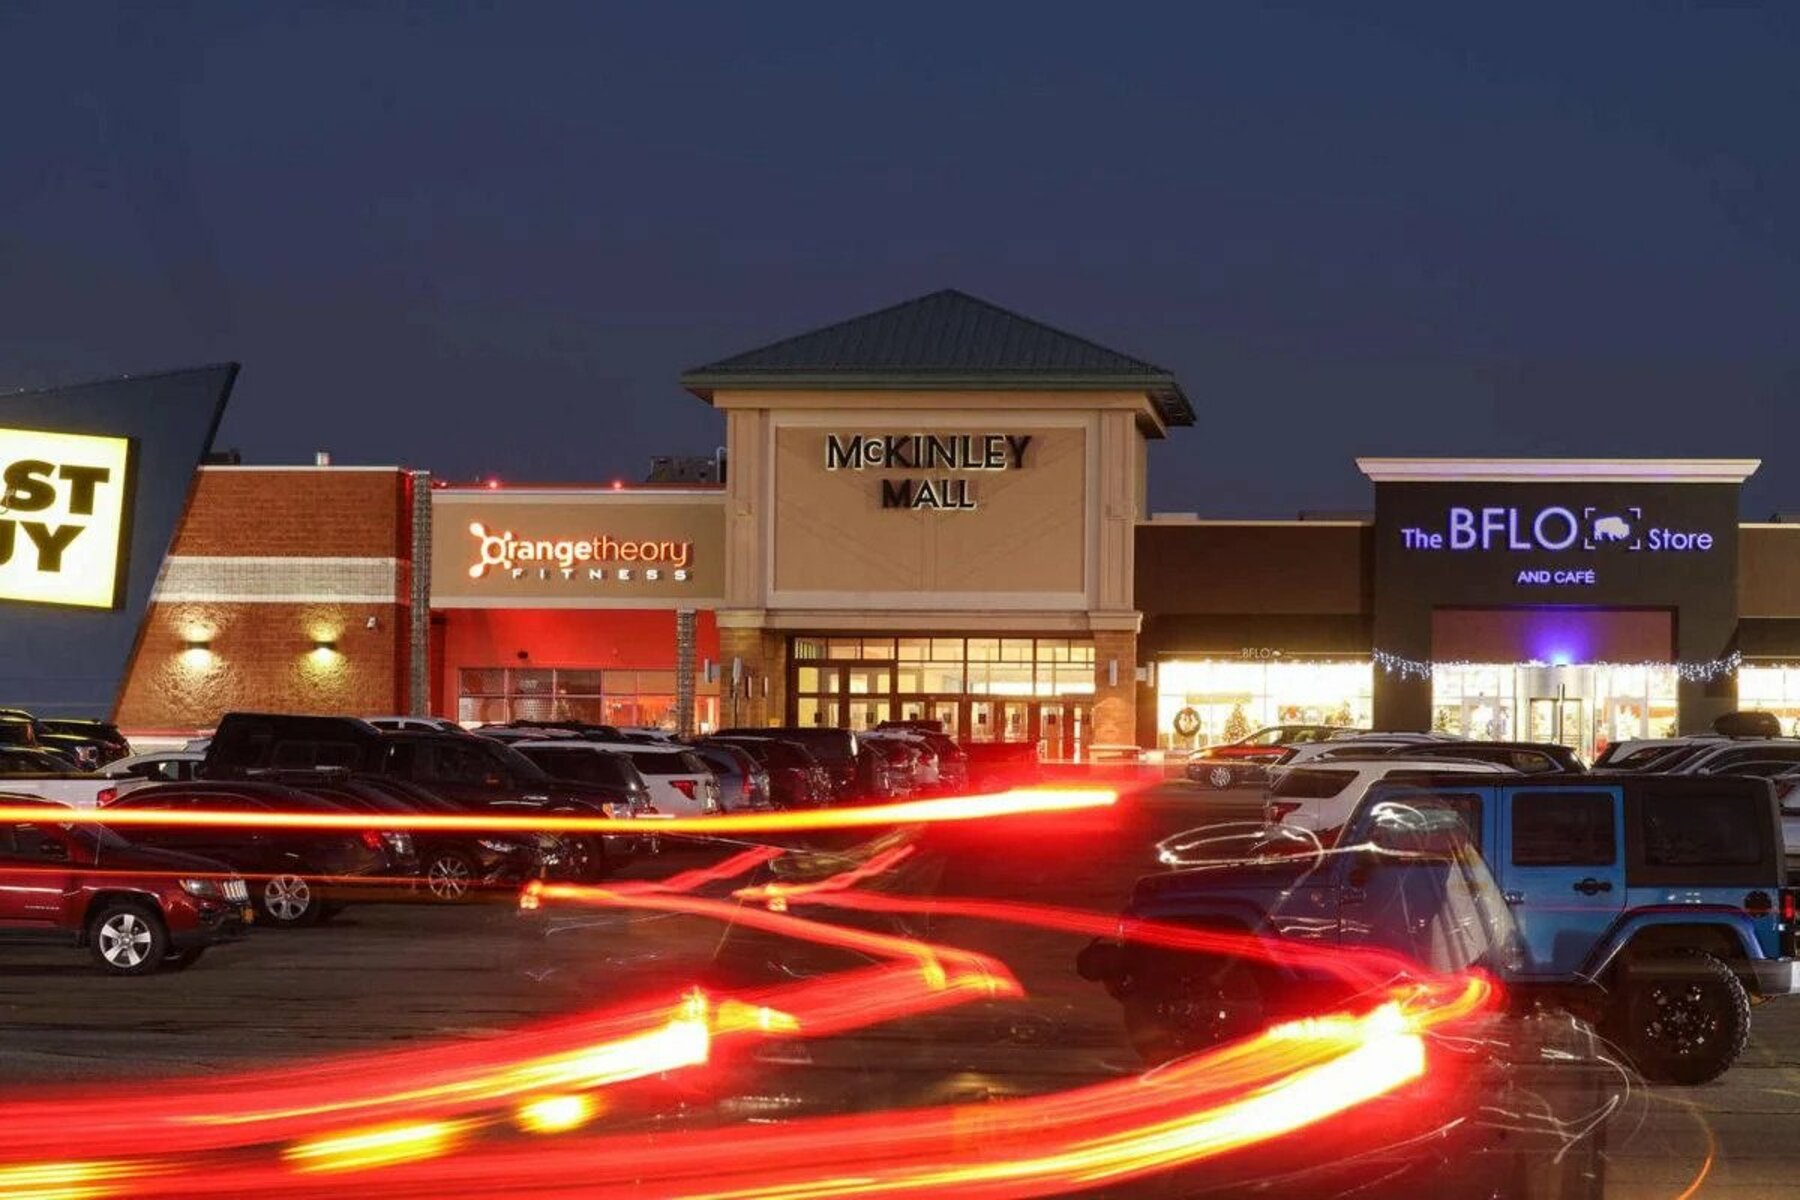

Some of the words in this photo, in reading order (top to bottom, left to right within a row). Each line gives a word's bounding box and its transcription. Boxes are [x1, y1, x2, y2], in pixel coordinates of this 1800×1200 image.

[826, 433, 1032, 470] McKINLEY
[0, 459, 110, 515] ST
[881, 478, 976, 510] MALL
[1401, 528, 1442, 549] The
[1449, 506, 1578, 550] BFLO
[1648, 528, 1714, 550] Store
[512, 568, 687, 580] FITNESS
[1517, 571, 1551, 584] AND
[1554, 568, 1596, 584] CAFÉ
[1242, 647, 1271, 659] BFLO
